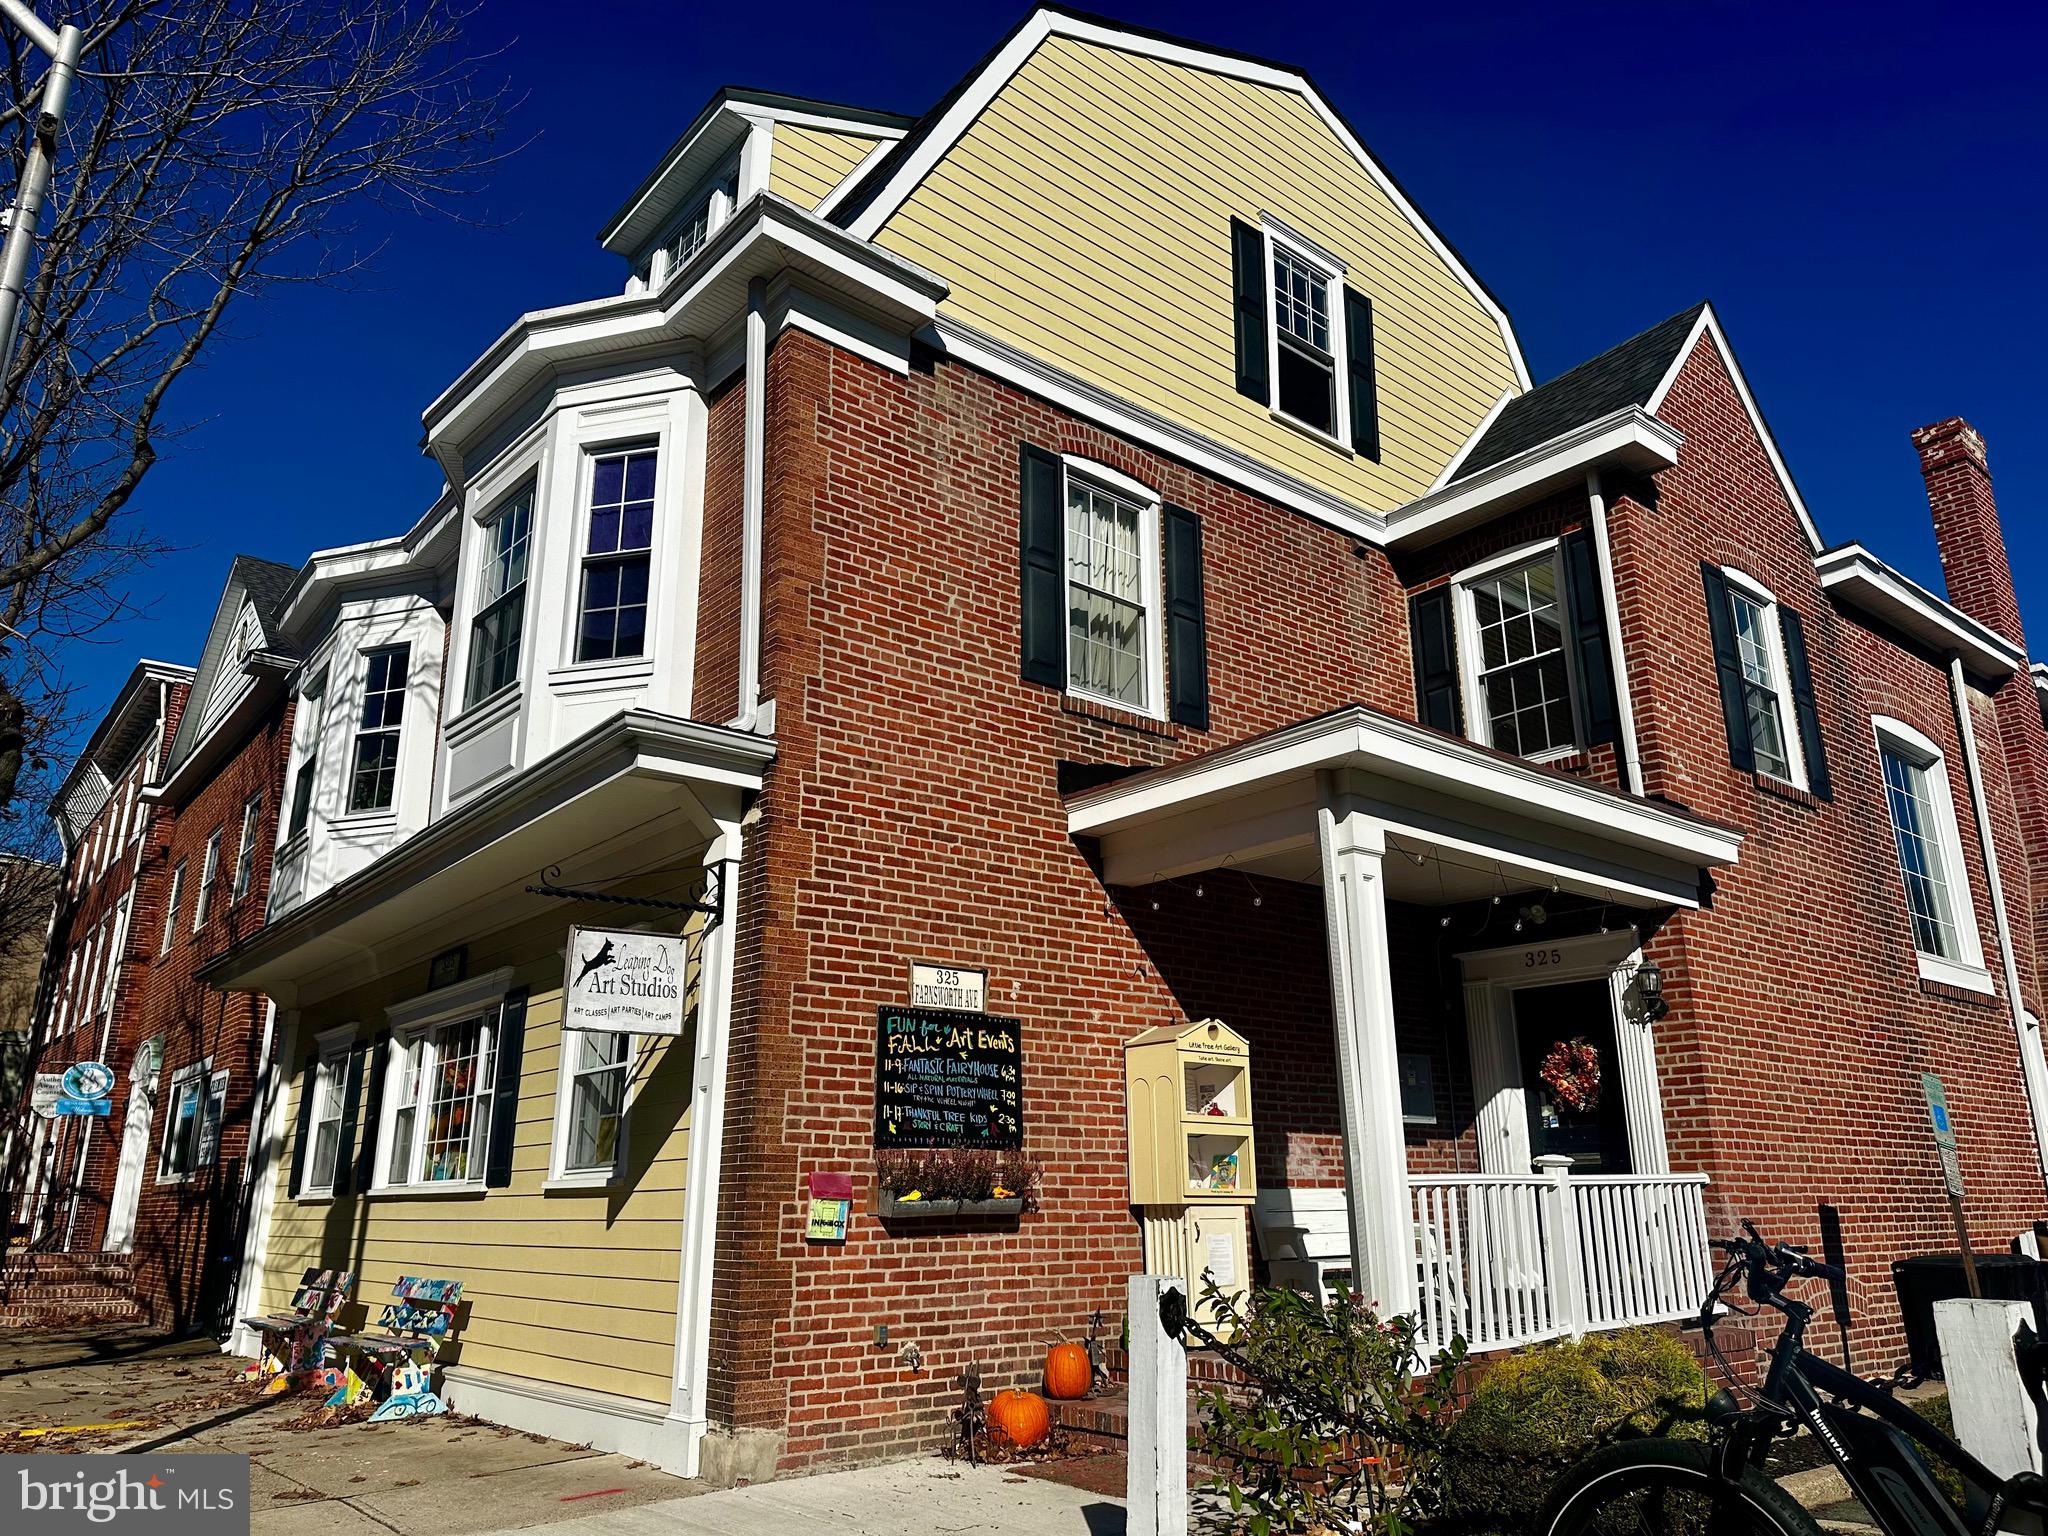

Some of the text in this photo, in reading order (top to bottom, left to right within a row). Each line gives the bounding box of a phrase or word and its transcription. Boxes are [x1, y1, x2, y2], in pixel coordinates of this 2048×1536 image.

[612, 944, 675, 983] Leaping Dog
[1525, 949, 1561, 968] 325
[588, 972, 678, 999] Art Studios
[936, 969, 959, 986] 325
[915, 984, 978, 1008] FARNSWORTH AVE
[574, 1005, 672, 1021] ART CLASSES ART PARTIES ART CAMPS
[887, 1016, 942, 1036] FUN for
[946, 1027, 974, 1050] Art
[978, 1029, 1015, 1053] Events
[1189, 1041, 1201, 1049] Little
[907, 1073, 918, 1081] ALL
[919, 1074, 945, 1083] NATURAL
[1005, 1074, 1016, 1083] PM
[905, 1083, 918, 1094] SIP
[924, 1083, 943, 1096] SPIN
[904, 1105, 941, 1121] THANKFUL
[943, 1110, 966, 1122] TREE
[939, 1122, 964, 1134] CRAFT
[1809, 1408, 1850, 1462] HIMIWAY
